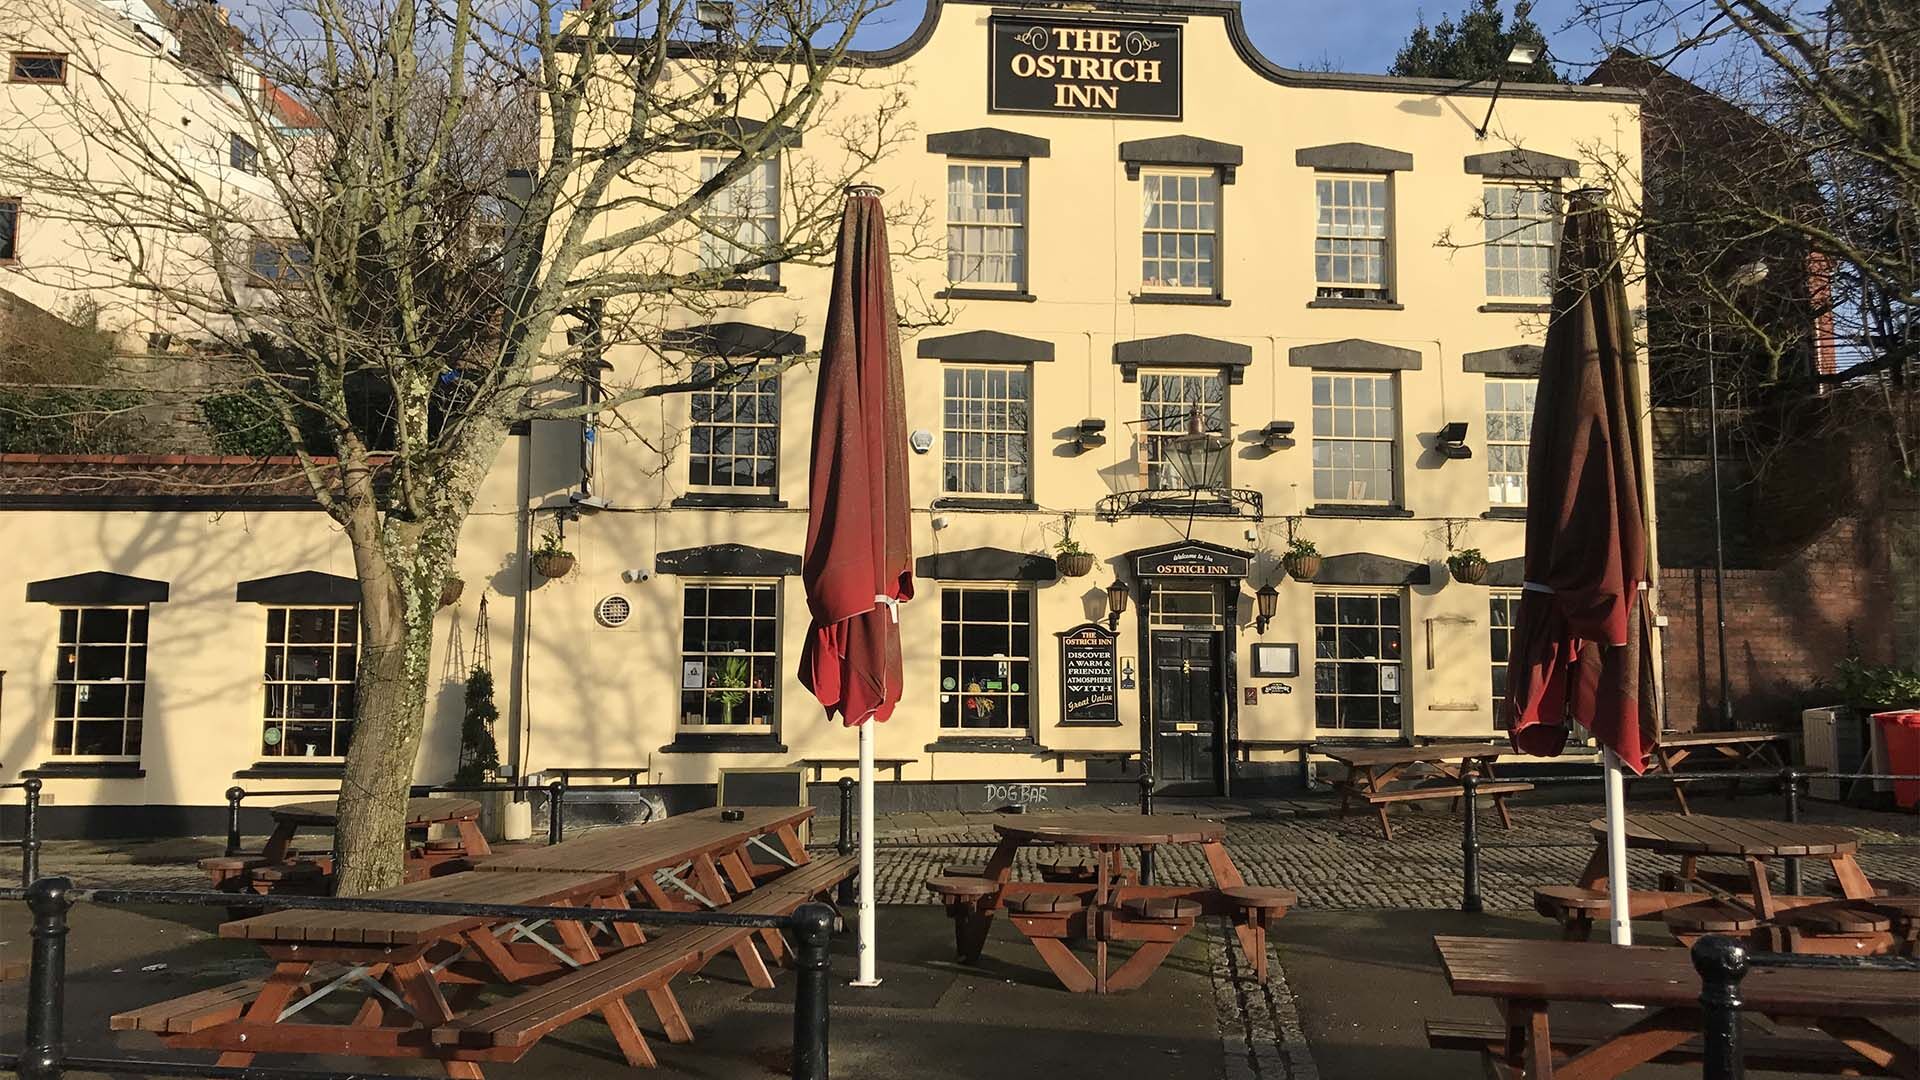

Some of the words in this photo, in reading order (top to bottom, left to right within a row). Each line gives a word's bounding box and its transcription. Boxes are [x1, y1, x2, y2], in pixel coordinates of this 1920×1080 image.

[1052, 27, 1121, 53] THE
[1011, 53, 1162, 83] OSTRICH
[1054, 83, 1119, 109] INN
[1173, 553, 1197, 561] Welcome
[1156, 565, 1205, 574] OSTRICH
[1068, 697, 1089, 712] Great
[1091, 693, 1112, 703] Value
[984, 784, 1018, 802] DOG
[1019, 785, 1049, 803] BAR
